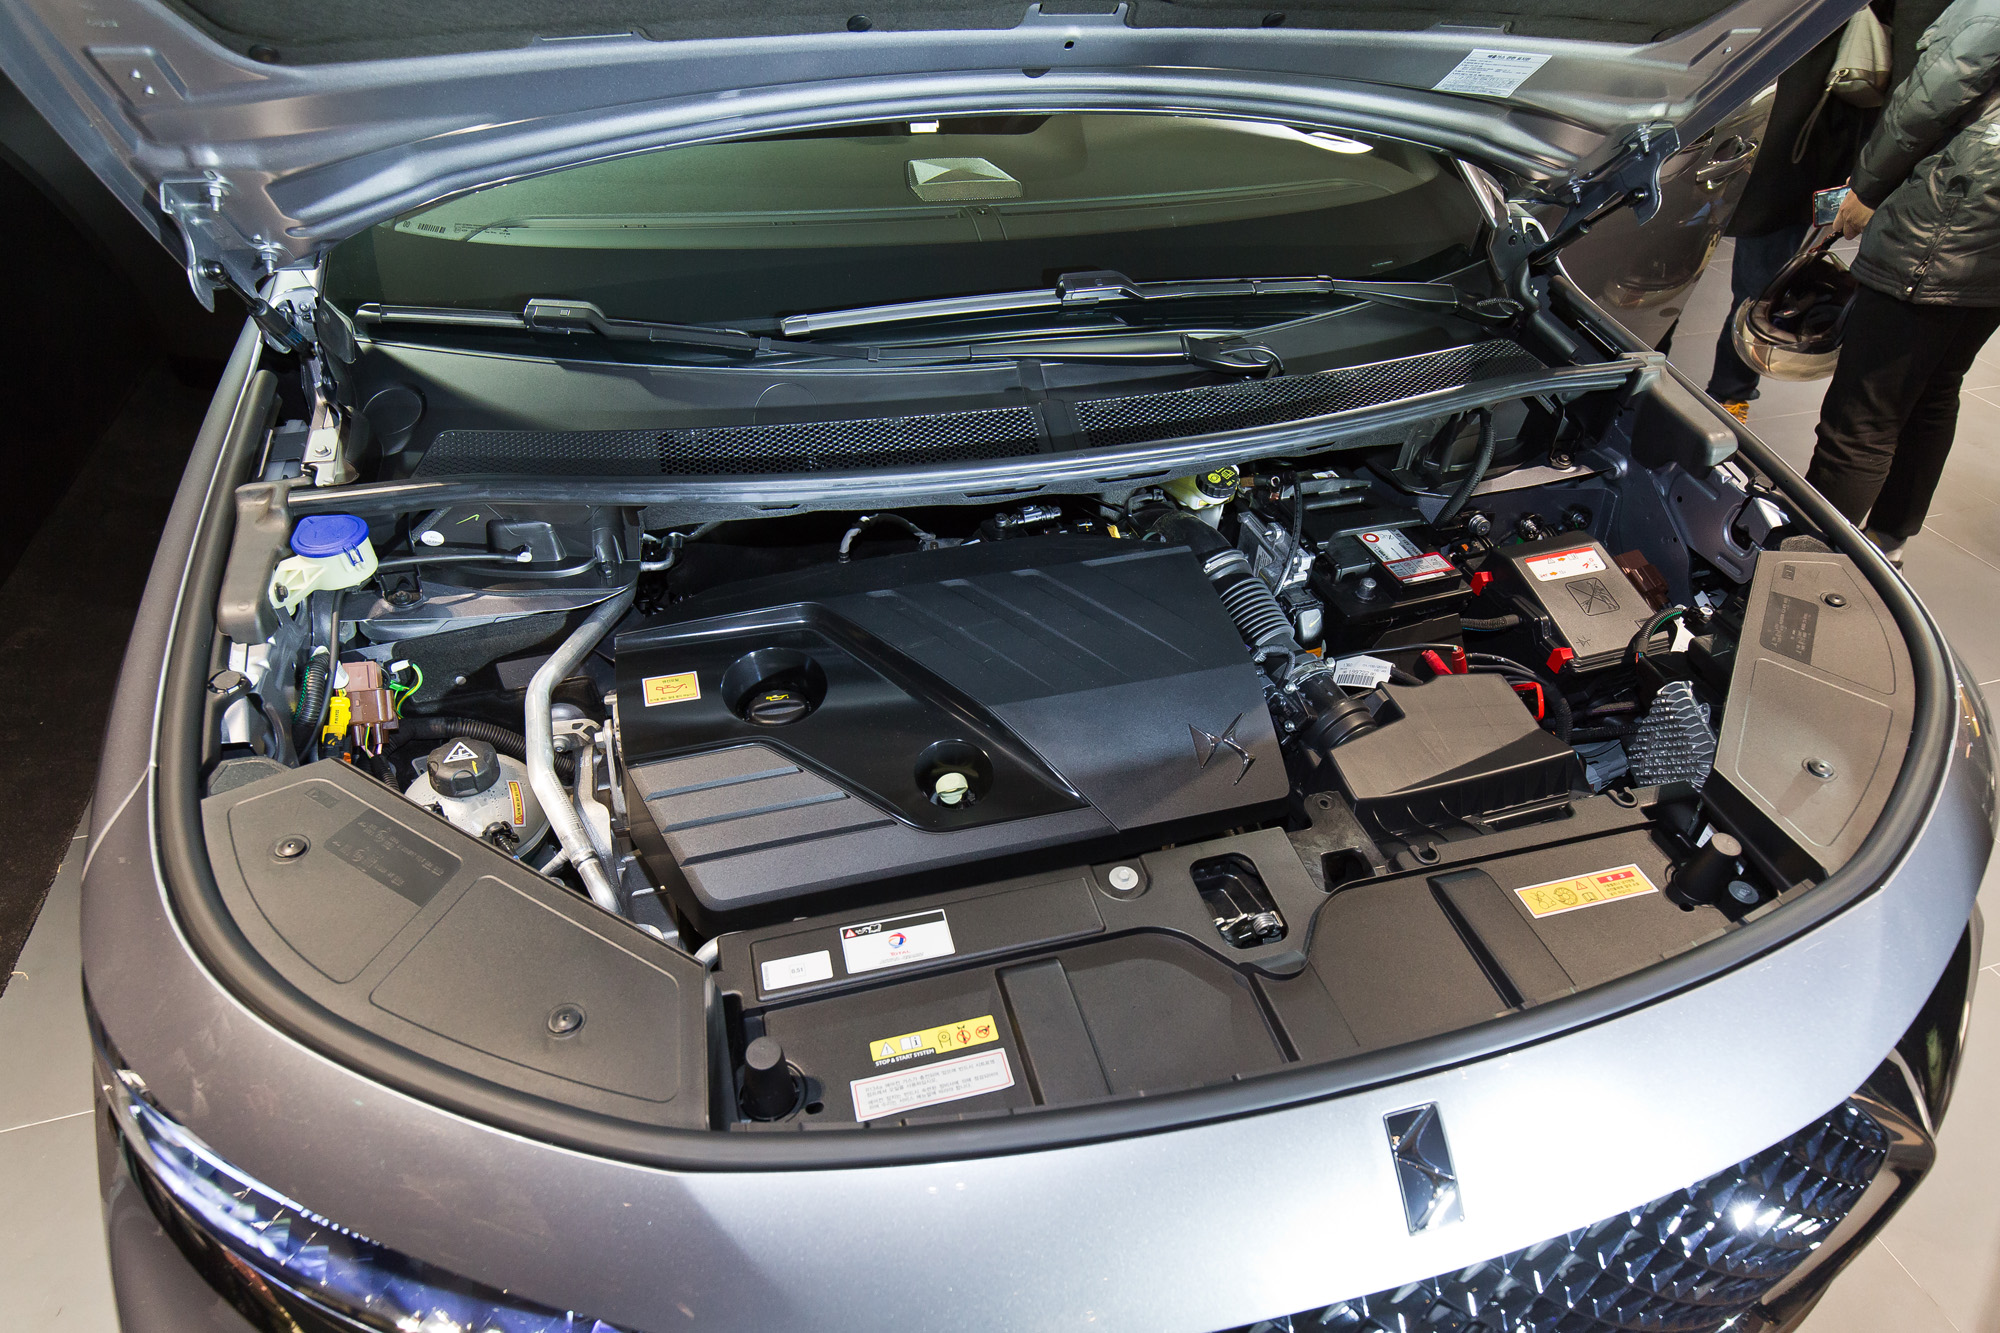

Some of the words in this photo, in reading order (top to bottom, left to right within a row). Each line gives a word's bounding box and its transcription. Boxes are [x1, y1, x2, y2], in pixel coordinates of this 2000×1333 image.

[875, 1058, 890, 1067] STOP
[895, 1053, 913, 1062] START
[913, 1048, 935, 1058] SYSTEM
